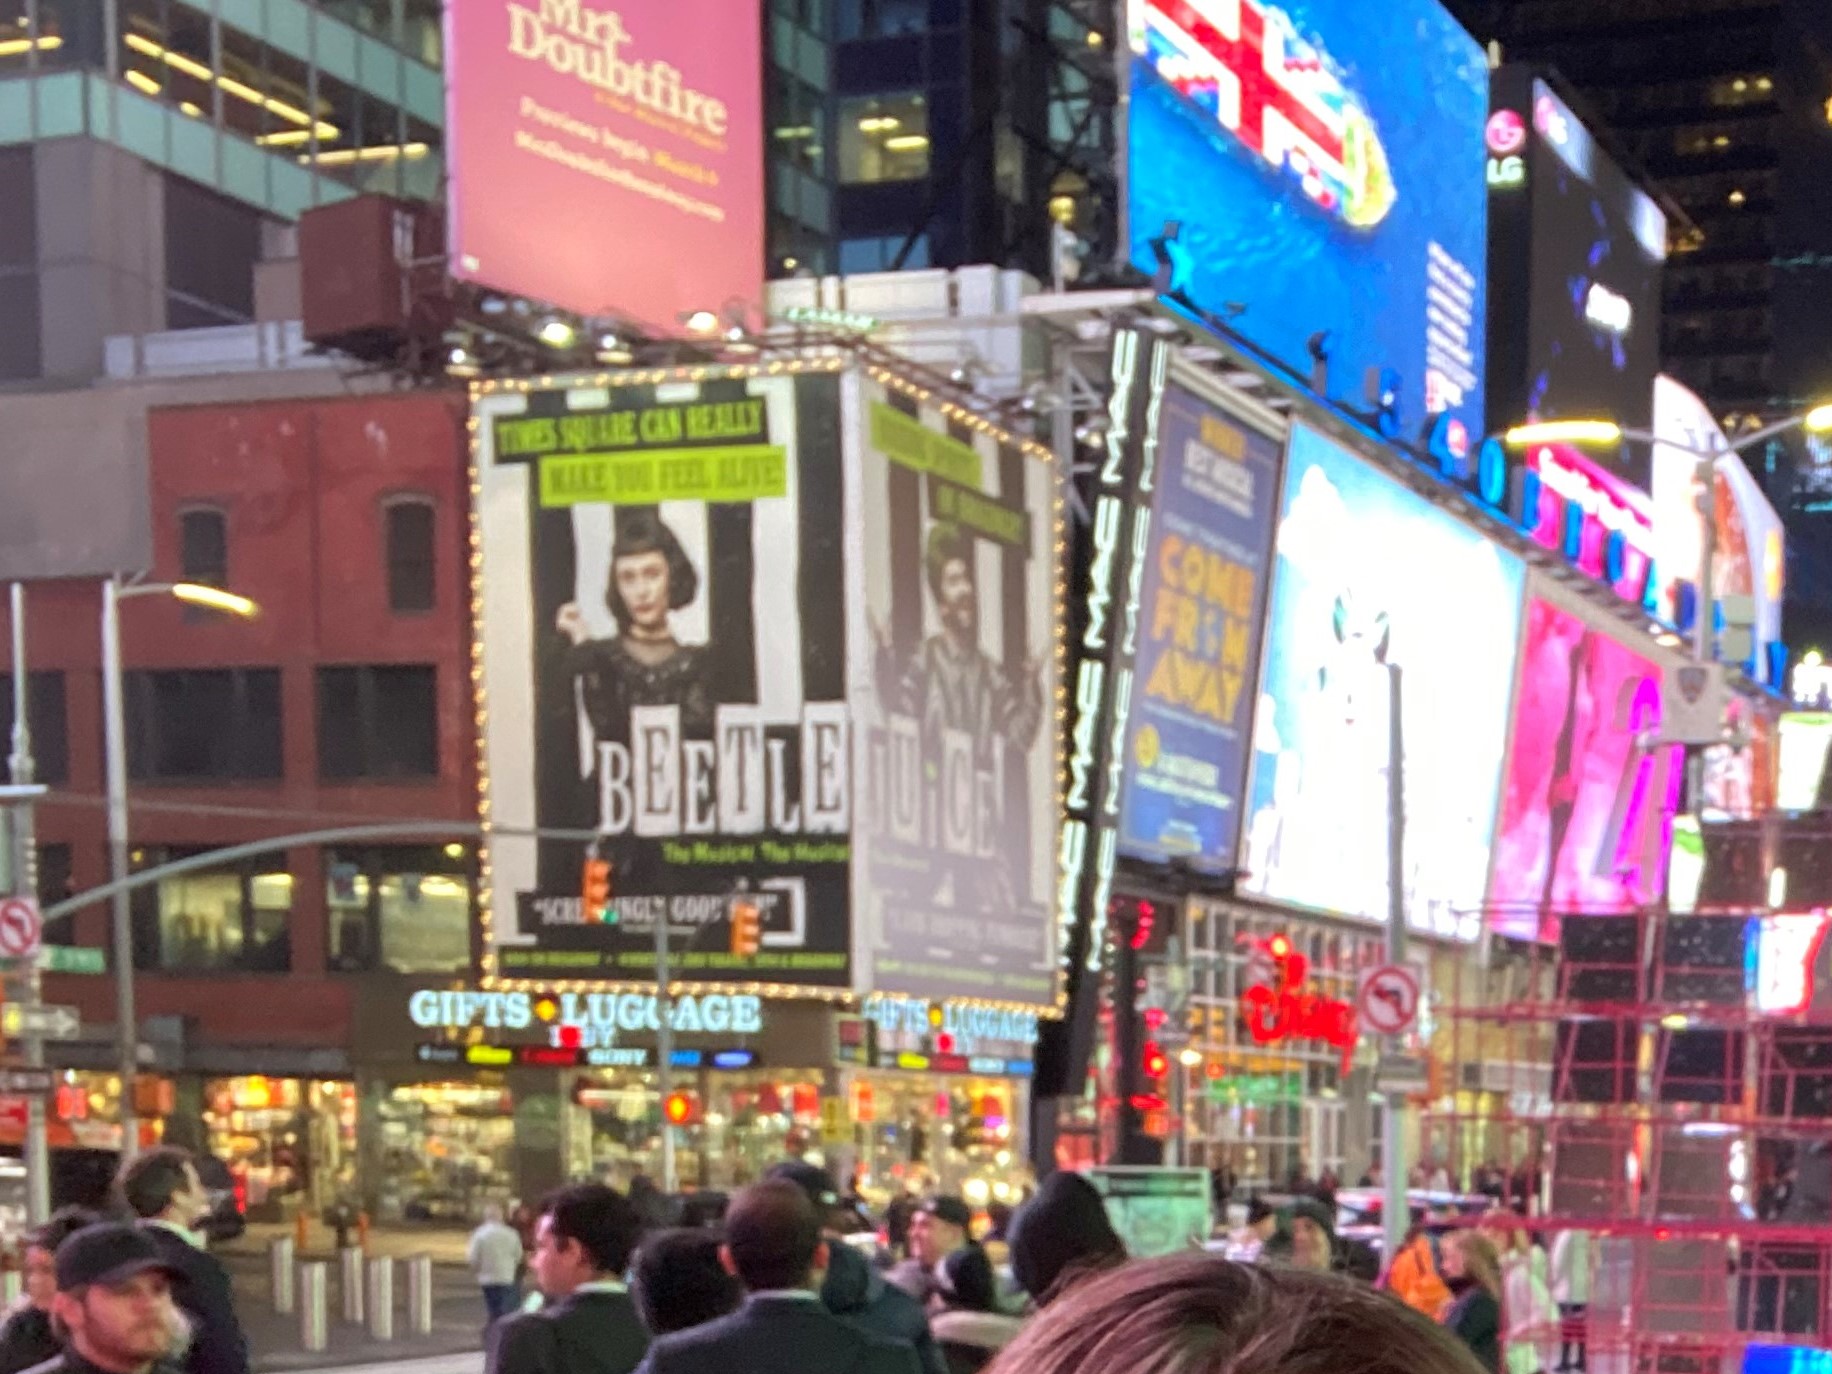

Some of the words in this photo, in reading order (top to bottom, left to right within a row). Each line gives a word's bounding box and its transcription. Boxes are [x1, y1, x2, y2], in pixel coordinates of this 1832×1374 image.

[506, 3, 728, 136] Doubtfire
[1486, 155, 1525, 184] LG
[598, 702, 848, 837] BEETLE
[409, 989, 531, 1030] GIFTS
